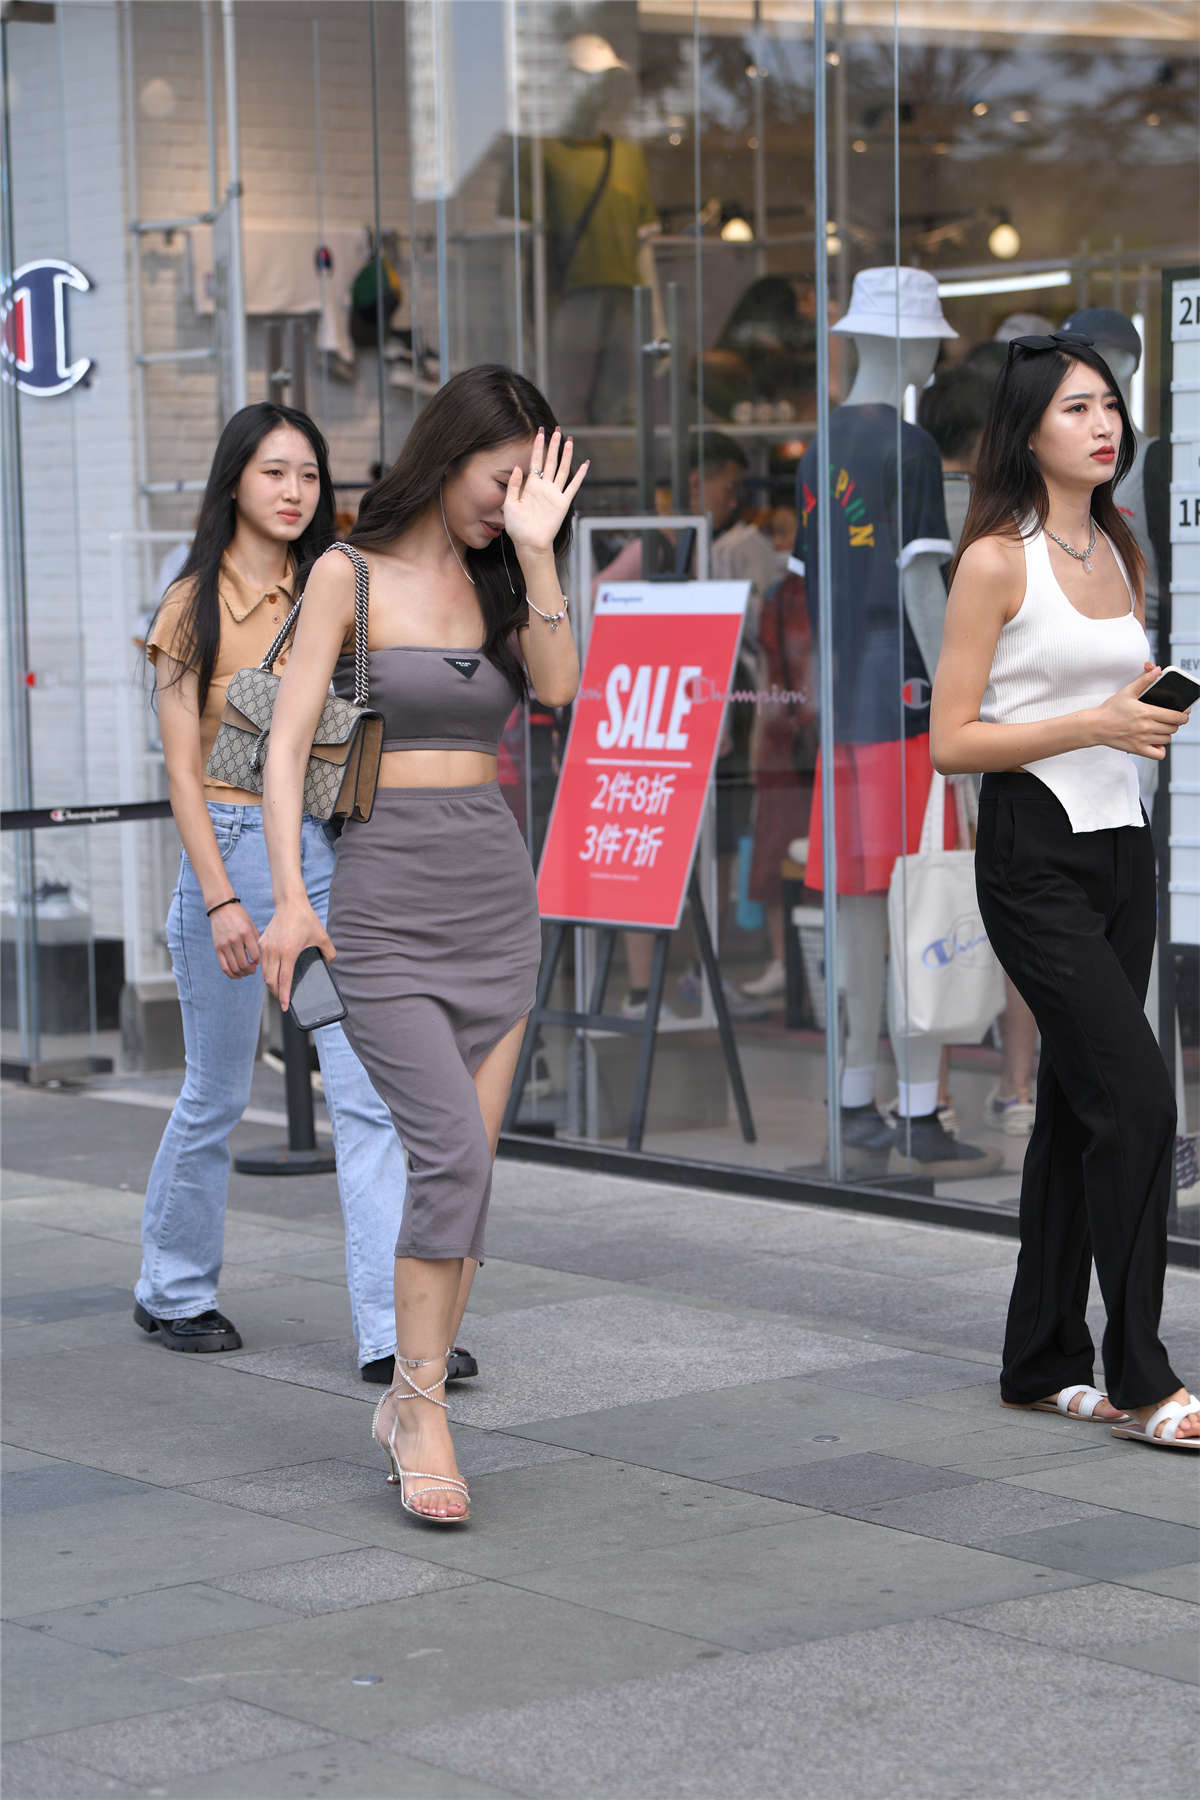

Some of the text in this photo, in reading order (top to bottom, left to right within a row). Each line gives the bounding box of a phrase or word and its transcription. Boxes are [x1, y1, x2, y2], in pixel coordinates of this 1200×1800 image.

[1179, 296, 1200, 325] 2
[597, 664, 702, 750] SALE
[685, 676, 808, 715] Champion
[590, 771, 676, 815] 2件8折
[579, 822, 664, 867] 3件7折
